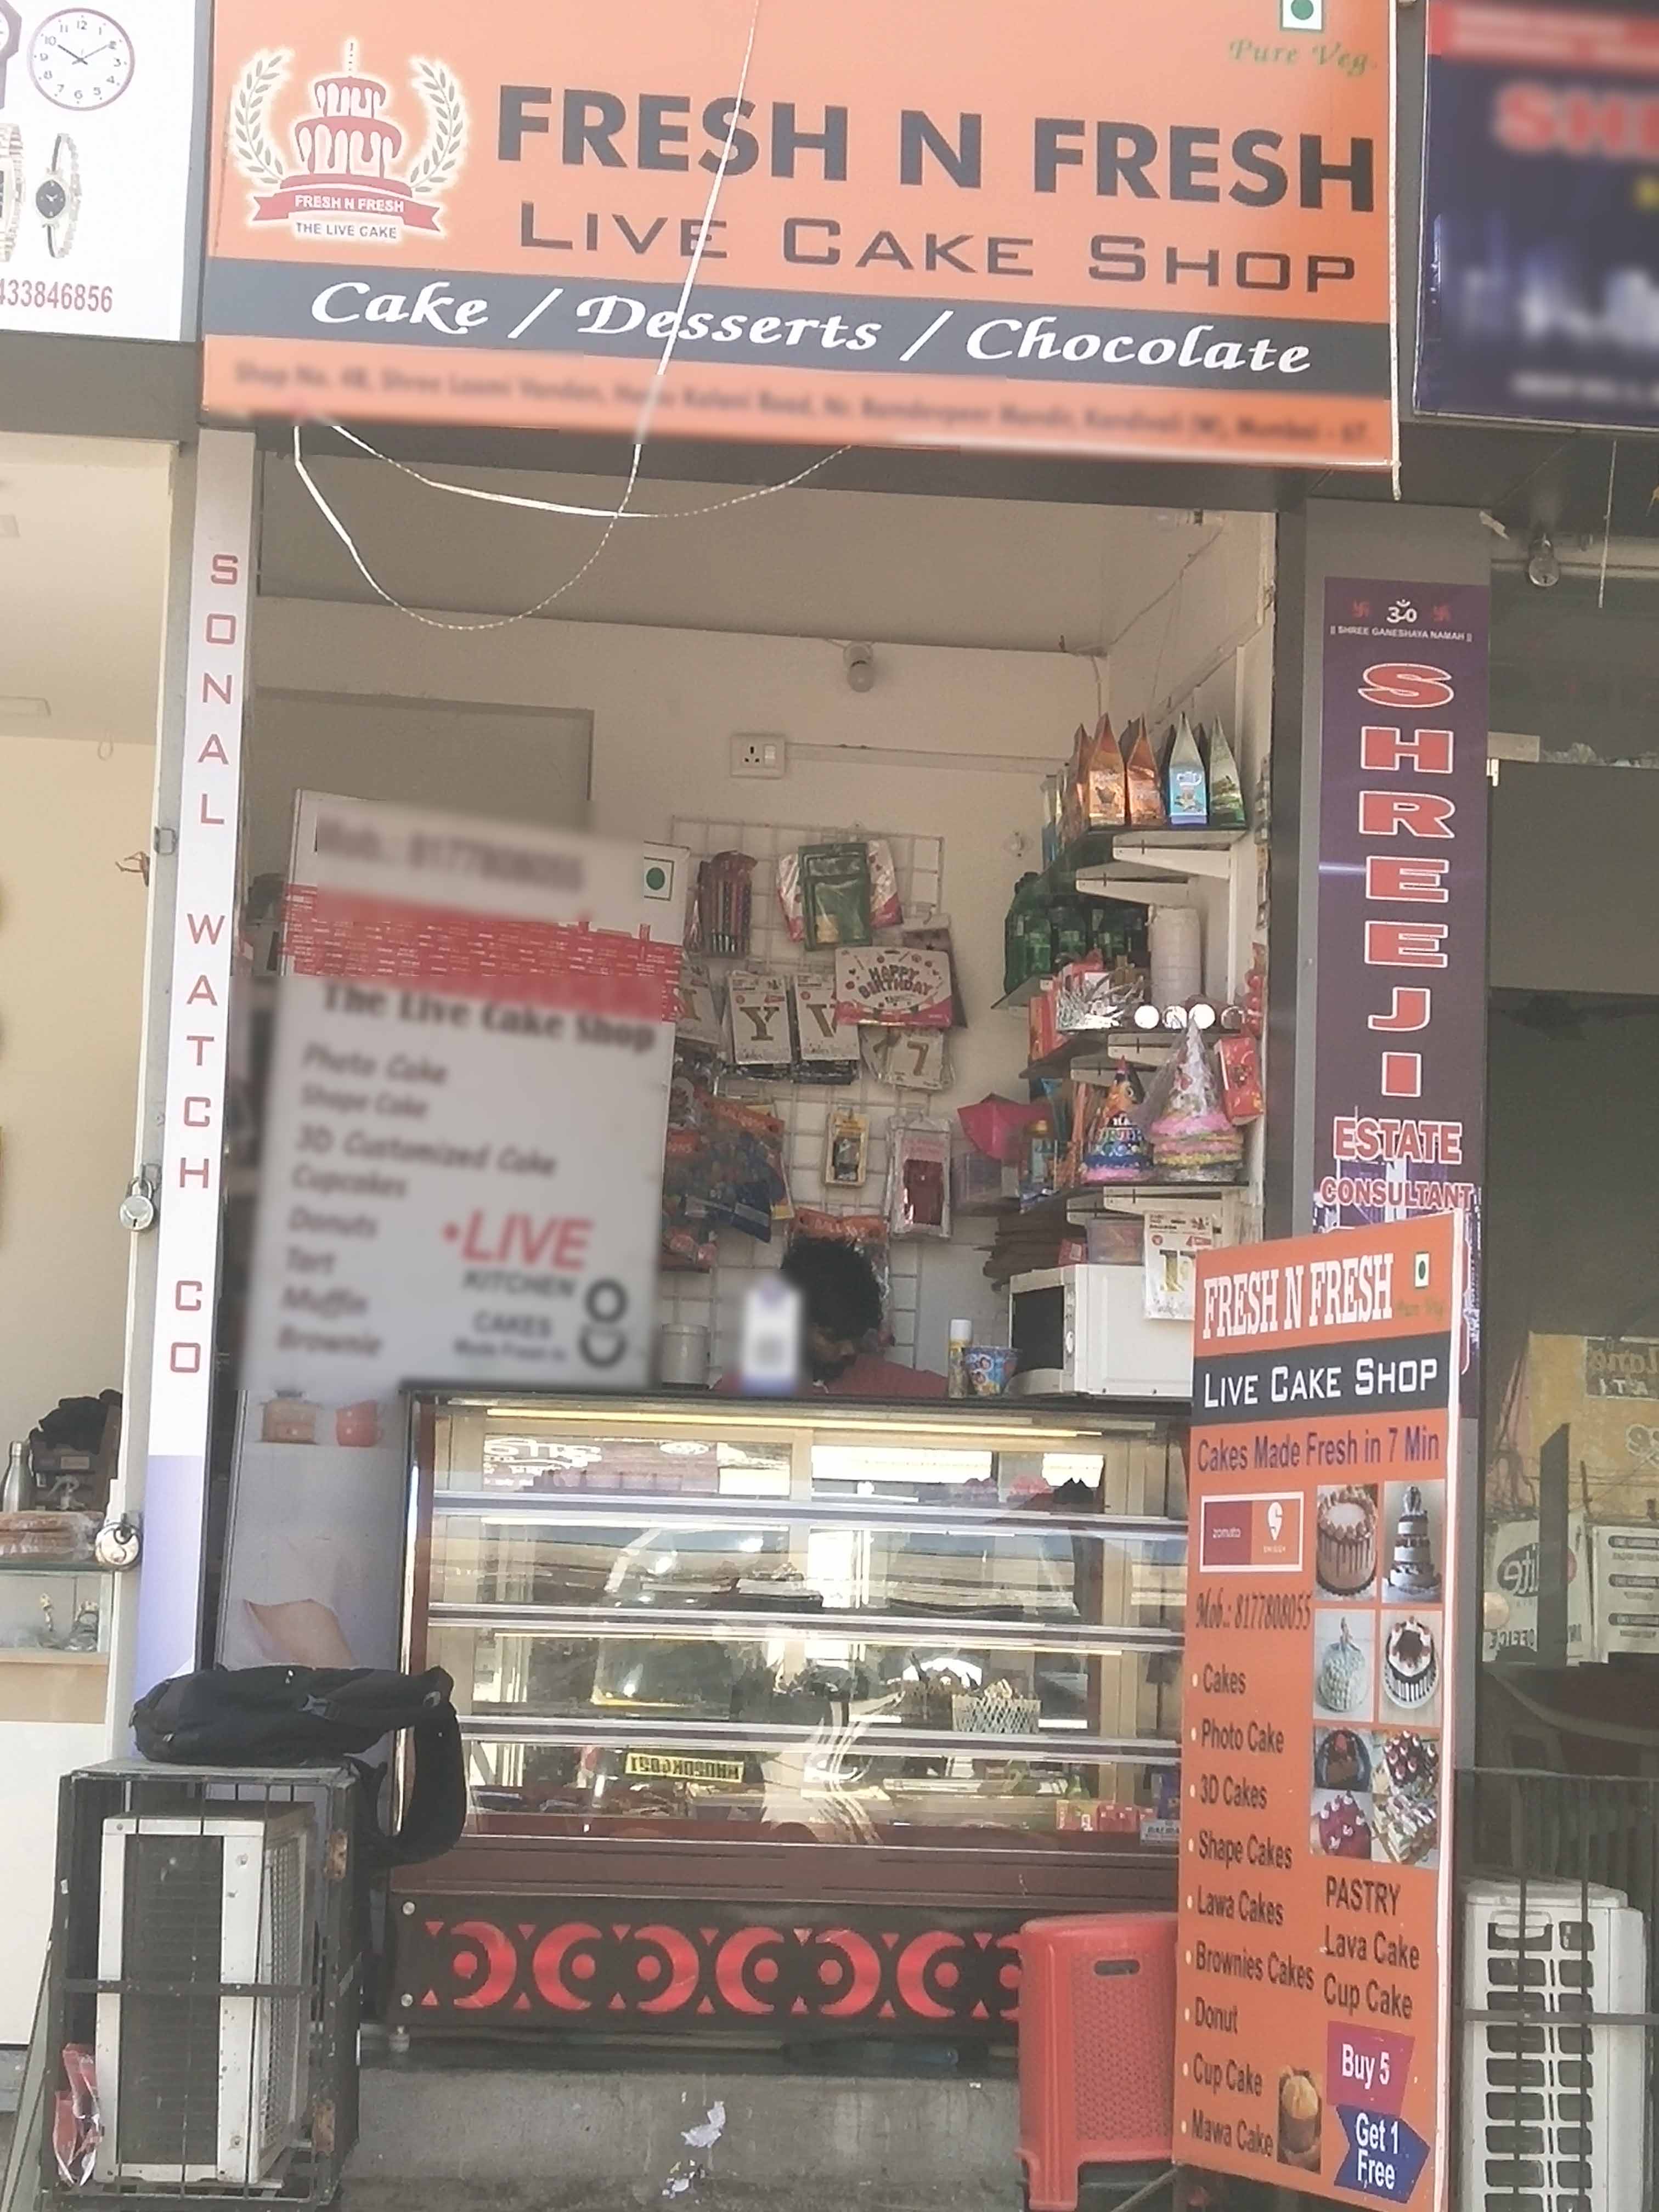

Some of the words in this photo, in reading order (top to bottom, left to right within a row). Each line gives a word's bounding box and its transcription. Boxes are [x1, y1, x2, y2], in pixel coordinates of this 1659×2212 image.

[498, 84, 848, 182] FRESH
[900, 109, 982, 189] N
[1034, 117, 1374, 213] FRESH
[295, 195, 341, 209] FRESH
[358, 198, 404, 212] FRESH
[296, 222, 321, 234] THE
[326, 224, 355, 236] LIVE
[359, 225, 397, 239] CAKE
[521, 201, 728, 259] LIVE
[783, 217, 1034, 276] CAKE
[1088, 234, 1356, 294] SHOP
[311, 281, 489, 335] Cake
[575, 295, 882, 352] Desserts
[966, 315, 1312, 374] Chocolate
[1338, 626, 1369, 636] SHREE
[1371, 627, 1429, 639] GANESHAYA
[1430, 629, 1465, 641] NAMAH
[198, 554, 239, 825] SONAL
[1357, 662, 1455, 1097] SHREEJI
[178, 913, 226, 1189] WATCH
[1333, 1116, 1463, 1164] ESTATE
[1320, 1176, 1475, 1209] CONSULTANT
[1203, 1268, 1279, 1340] FRESH
[1284, 1265, 1304, 1330] N
[1309, 1253, 1395, 1327] FRESH
[170, 1279, 202, 1373] CO
[1204, 1373, 1259, 1408] LIVE
[1271, 1365, 1341, 1403] CAKE
[1355, 1357, 1437, 1396] SHOP
[1198, 1437, 1248, 1472] Cakes
[1255, 1434, 1300, 1468] Made
[1306, 1429, 1357, 1466] Fresh
[1365, 1431, 1381, 1463] in
[1389, 1427, 1398, 1462] 7
[1405, 1426, 1439, 1462] Min
[1203, 1663, 1246, 1695] Cakes
[1201, 1718, 1244, 1751] Photo
[1248, 1722, 1284, 1754] Cake
[1199, 1774, 1219, 1805] 3D
[1223, 1777, 1267, 1809] Cakes
[1199, 1830, 1243, 1869] Shape
[1246, 1835, 1293, 1869] Cakes
[1197, 1885, 1234, 1919] Lawa
[1238, 1889, 1284, 1926] Cakes
[1325, 1875, 1402, 1916] PASTRY
[1196, 1940, 1263, 1981] Brownies
[1268, 1953, 1315, 1991] Cakes
[1324, 1925, 1367, 1962] Lava
[1373, 1931, 1420, 1971] Cake
[1194, 1996, 1238, 2034] Donut
[1323, 1973, 1360, 2016] Cup
[1366, 1979, 1413, 2020] Cake
[1193, 2053, 1222, 2095] Cup
[1226, 2059, 1263, 2096] Cake
[1342, 2044, 1375, 2090] Buy
[1379, 2052, 1390, 2085] 5
[1192, 2109, 1232, 2147] Mawa
[1236, 2121, 1273, 2158] Cake
[1356, 2112, 1386, 2152] Get
[1390, 2120, 1399, 2154] 1
[1357, 2149, 1396, 2190] Free
